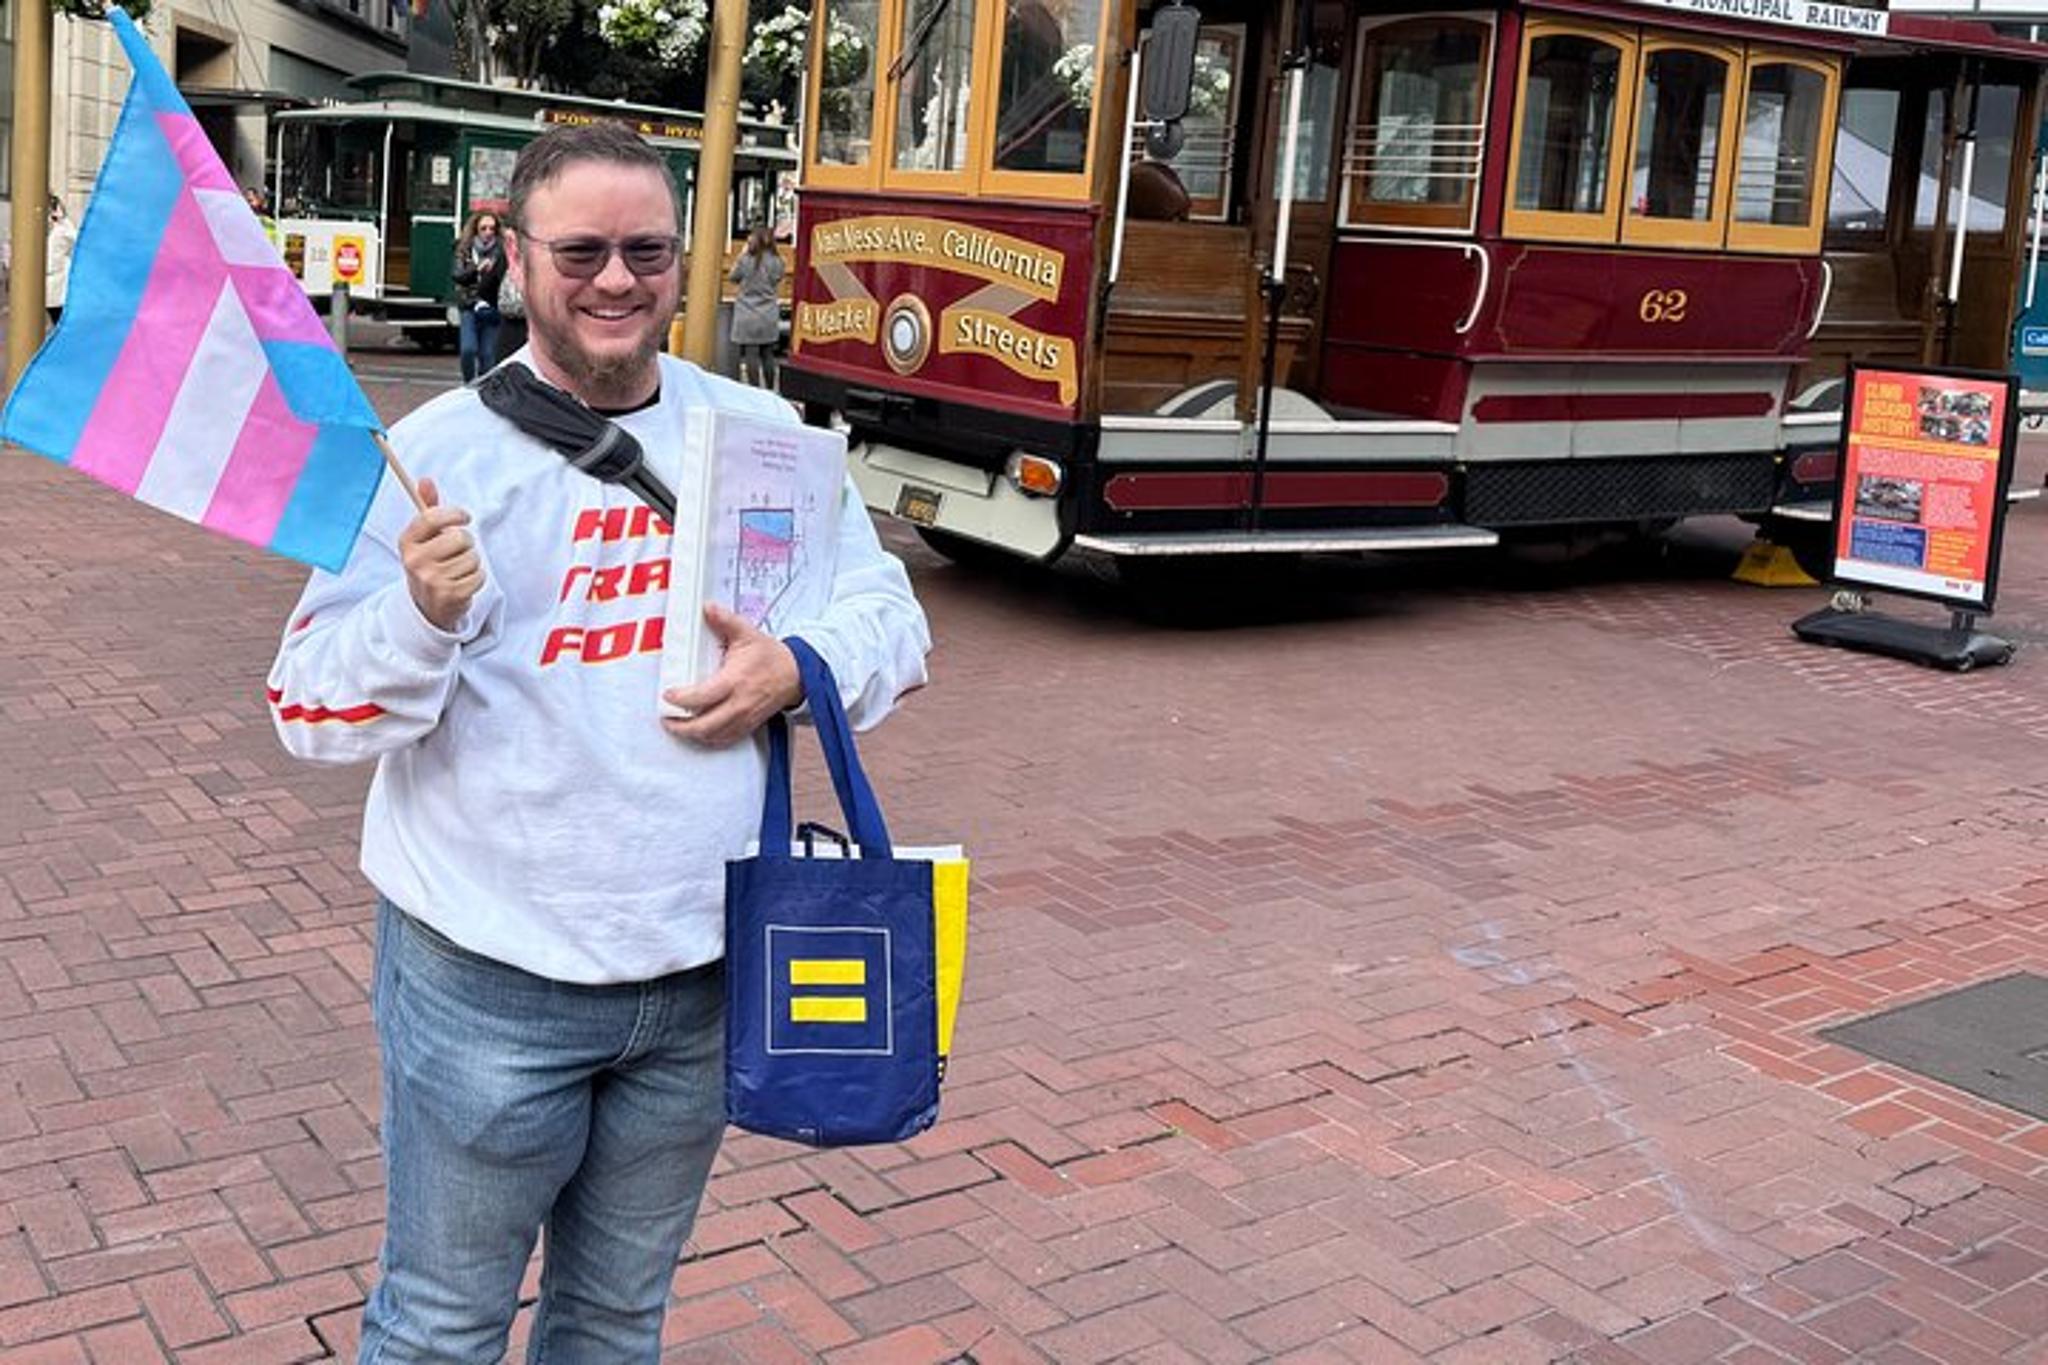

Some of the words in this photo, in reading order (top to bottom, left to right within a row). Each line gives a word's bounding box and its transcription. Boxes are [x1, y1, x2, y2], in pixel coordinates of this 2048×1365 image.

[1804, 5, 1882, 32] RAILWAY
[843, 224, 884, 252] Ness
[943, 229, 1057, 287] California
[1640, 288, 1688, 323] 62
[815, 303, 873, 336] Market
[956, 315, 1062, 371] Streets
